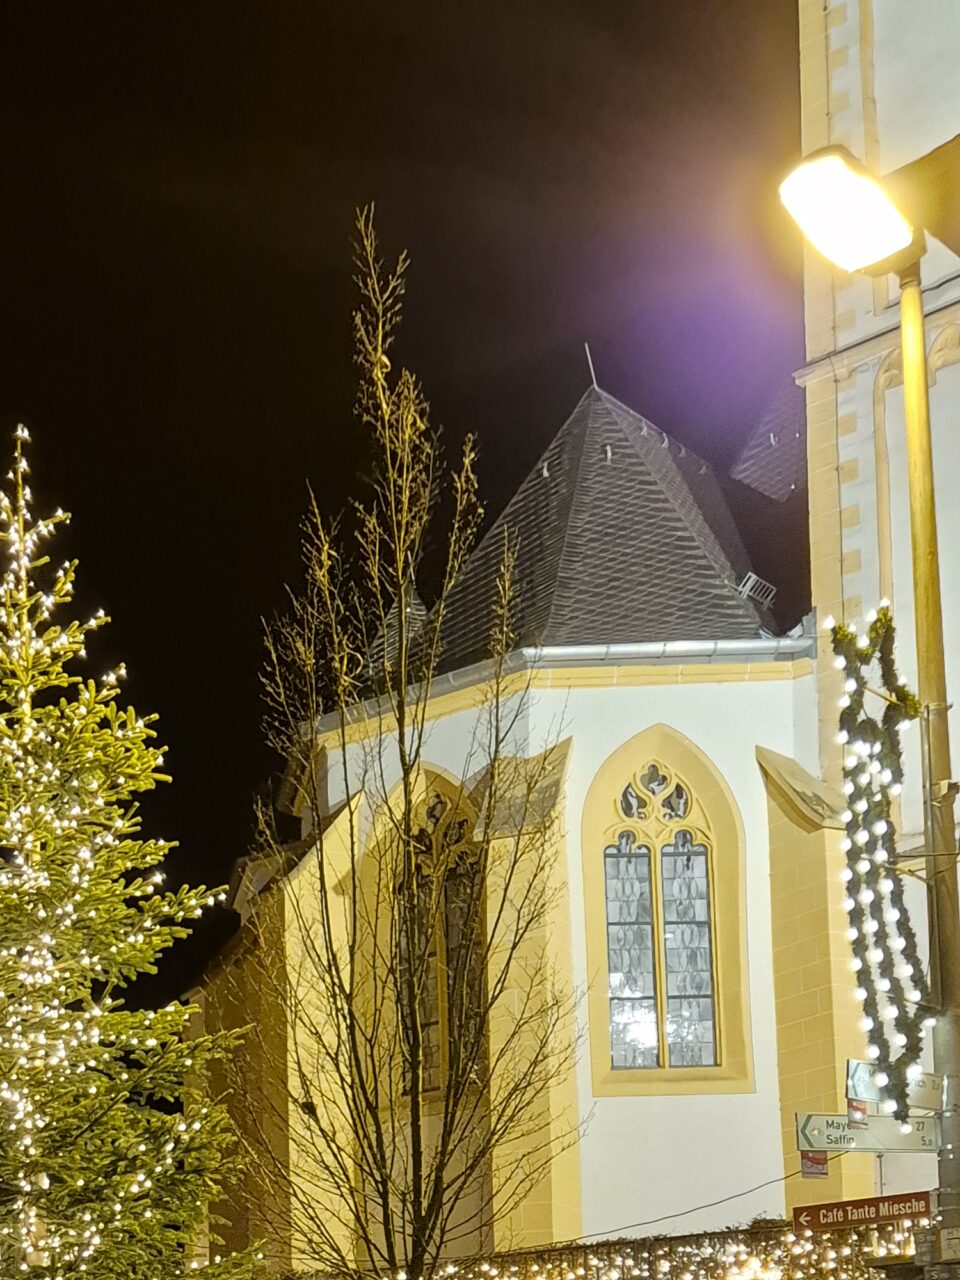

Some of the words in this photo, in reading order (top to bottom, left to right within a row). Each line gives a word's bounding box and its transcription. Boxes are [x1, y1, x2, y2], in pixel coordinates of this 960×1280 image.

[915, 1121, 925, 1131] 27
[819, 1207, 844, 1224] Café
[846, 1204, 876, 1221] Tante
[879, 1198, 926, 1217] Miesche
